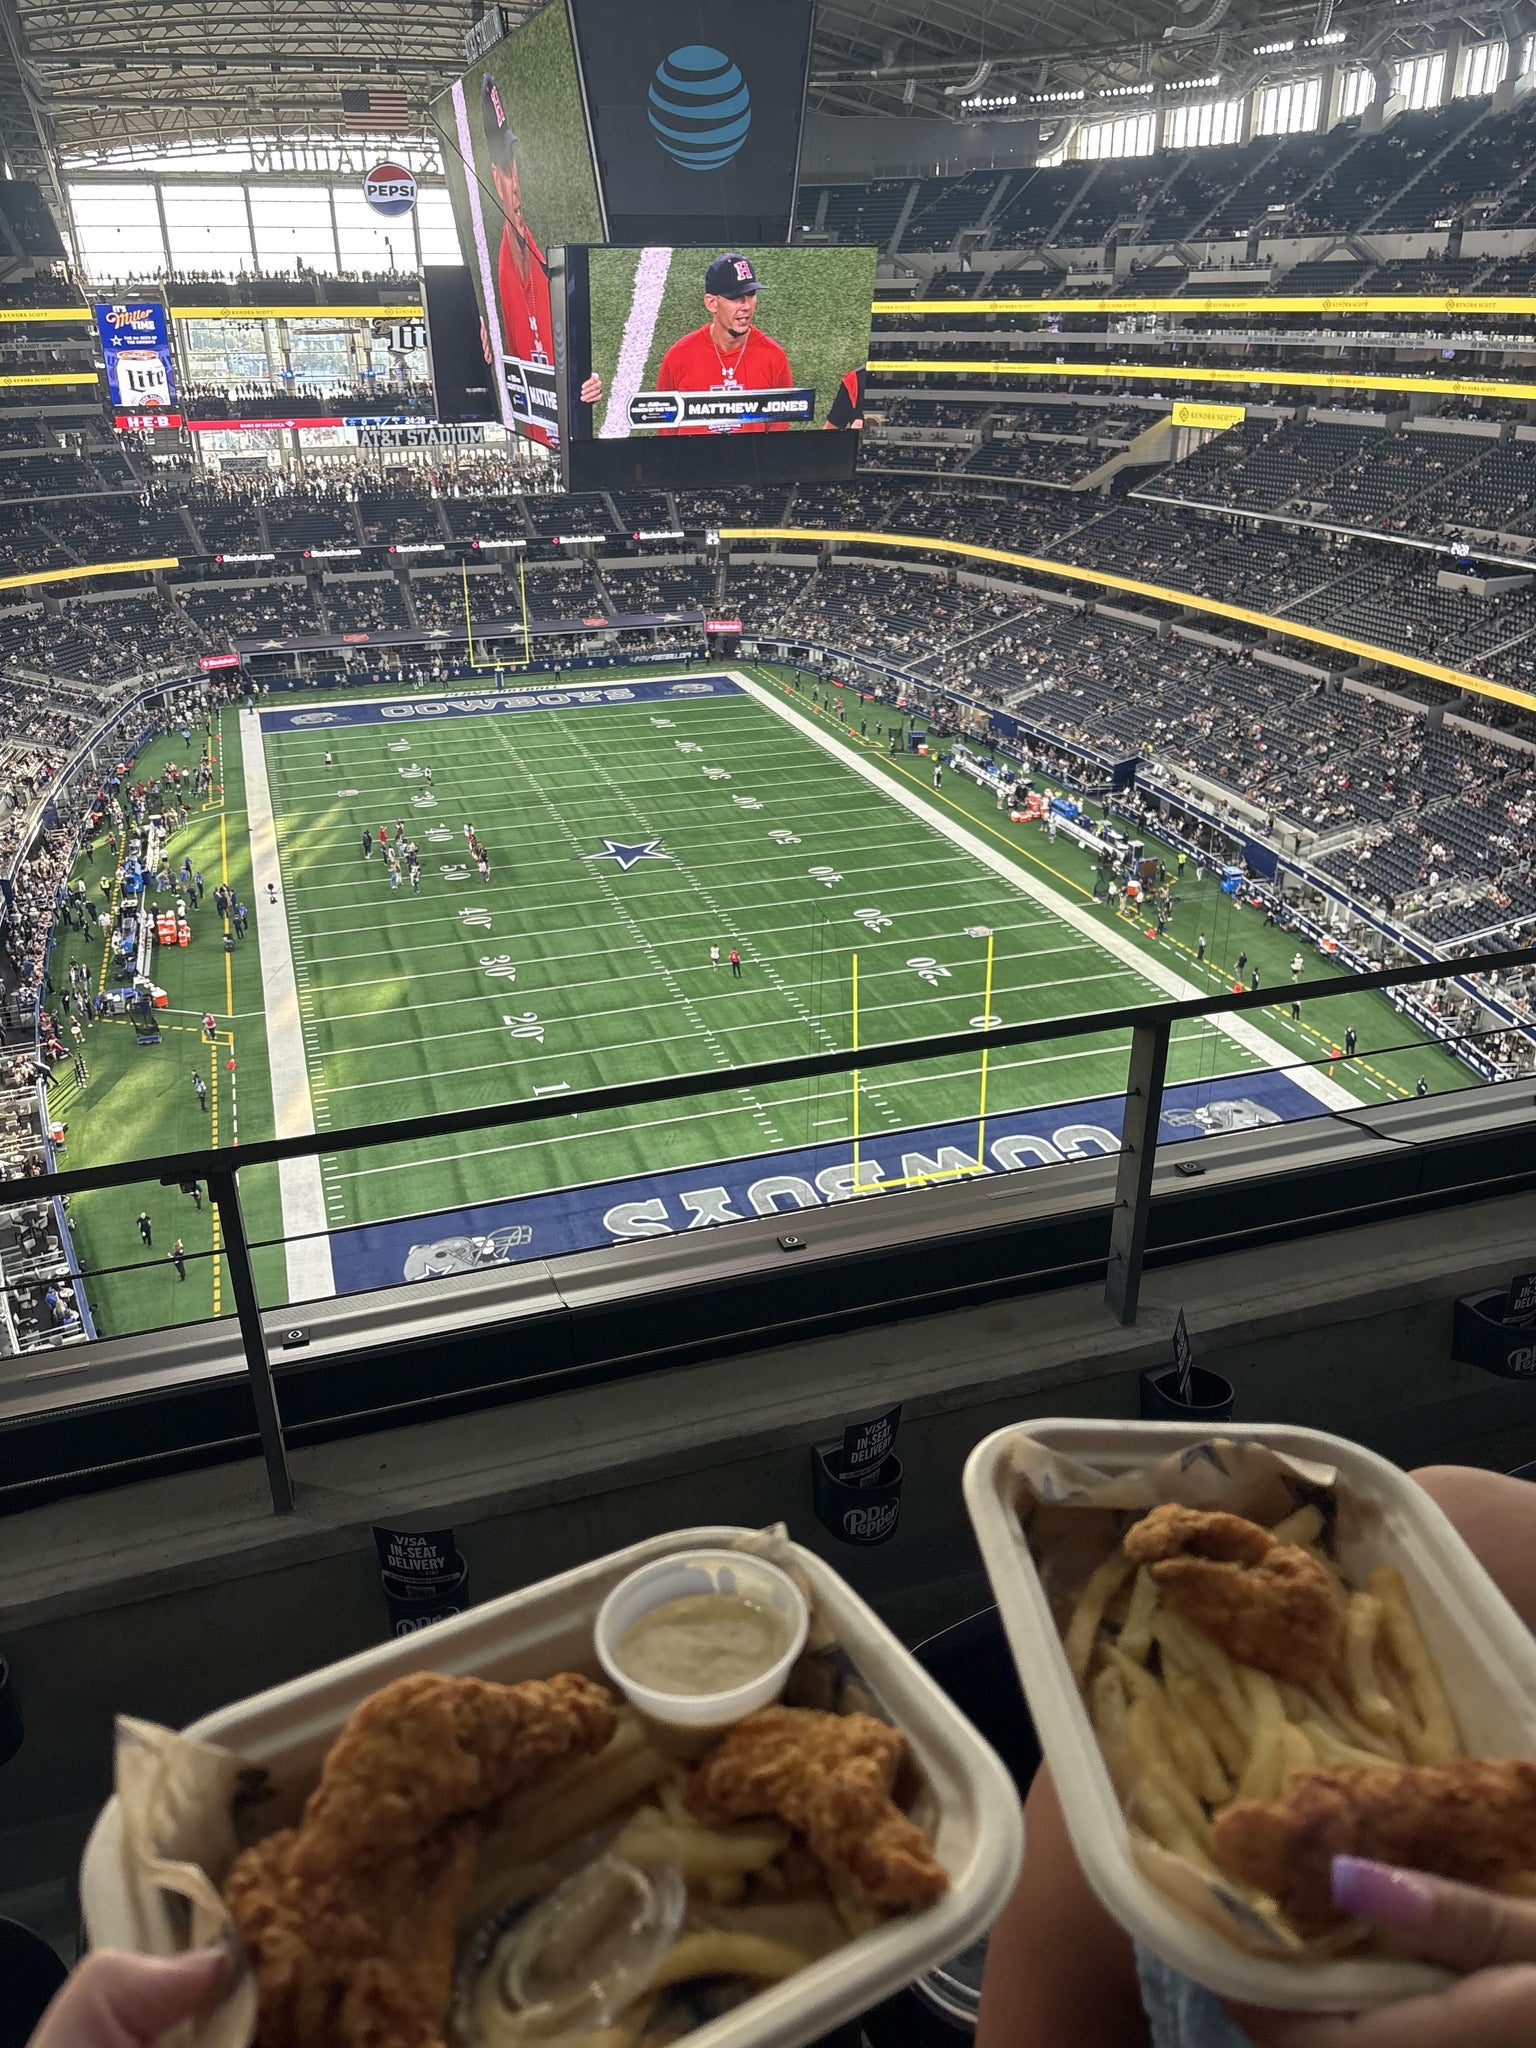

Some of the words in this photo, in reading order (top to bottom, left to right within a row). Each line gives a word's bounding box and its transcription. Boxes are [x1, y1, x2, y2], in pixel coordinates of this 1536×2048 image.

[367, 185, 415, 197] PEPSI
[734, 261, 753, 281] H
[105, 309, 154, 330] Miller
[131, 320, 156, 331] TIME
[125, 369, 164, 393] Lite
[688, 401, 760, 415] MATTHEW
[761, 400, 808, 412] JONES
[1190, 412, 1215, 420] KENDRA
[360, 427, 403, 448] AT&T
[407, 425, 485, 446] STADIUM
[479, 539, 527, 548] Blockchain.com
[559, 535, 606, 544] Blockchain.com
[639, 530, 685, 540] Blockchain.com
[310, 549, 362, 558] Blockchain.com
[396, 544, 445, 553] Blockchain.com
[223, 553, 275, 562] Blockchain.com
[381, 688, 636, 718] COWBOYS
[410, 794, 438, 808] 30
[424, 828, 454, 842] 40
[767, 829, 802, 845] 50
[440, 863, 471, 880] 50
[807, 866, 844, 883] 40
[458, 907, 492, 925] 40
[853, 907, 893, 928] 30
[479, 954, 516, 977] 30
[906, 956, 952, 981] 20
[502, 1012, 545, 1038] 20
[864, 1418, 888, 1436] VISA
[857, 1424, 892, 1450] IN-SEAT
[851, 1434, 893, 1464] DELIVERY
[843, 1503, 899, 1537] Pepper
[867, 1504, 889, 1522] Dr
[393, 1534, 428, 1547] VISA
[389, 1543, 437, 1559] IN-SEAT
[387, 1554, 445, 1571] DELIVERY
